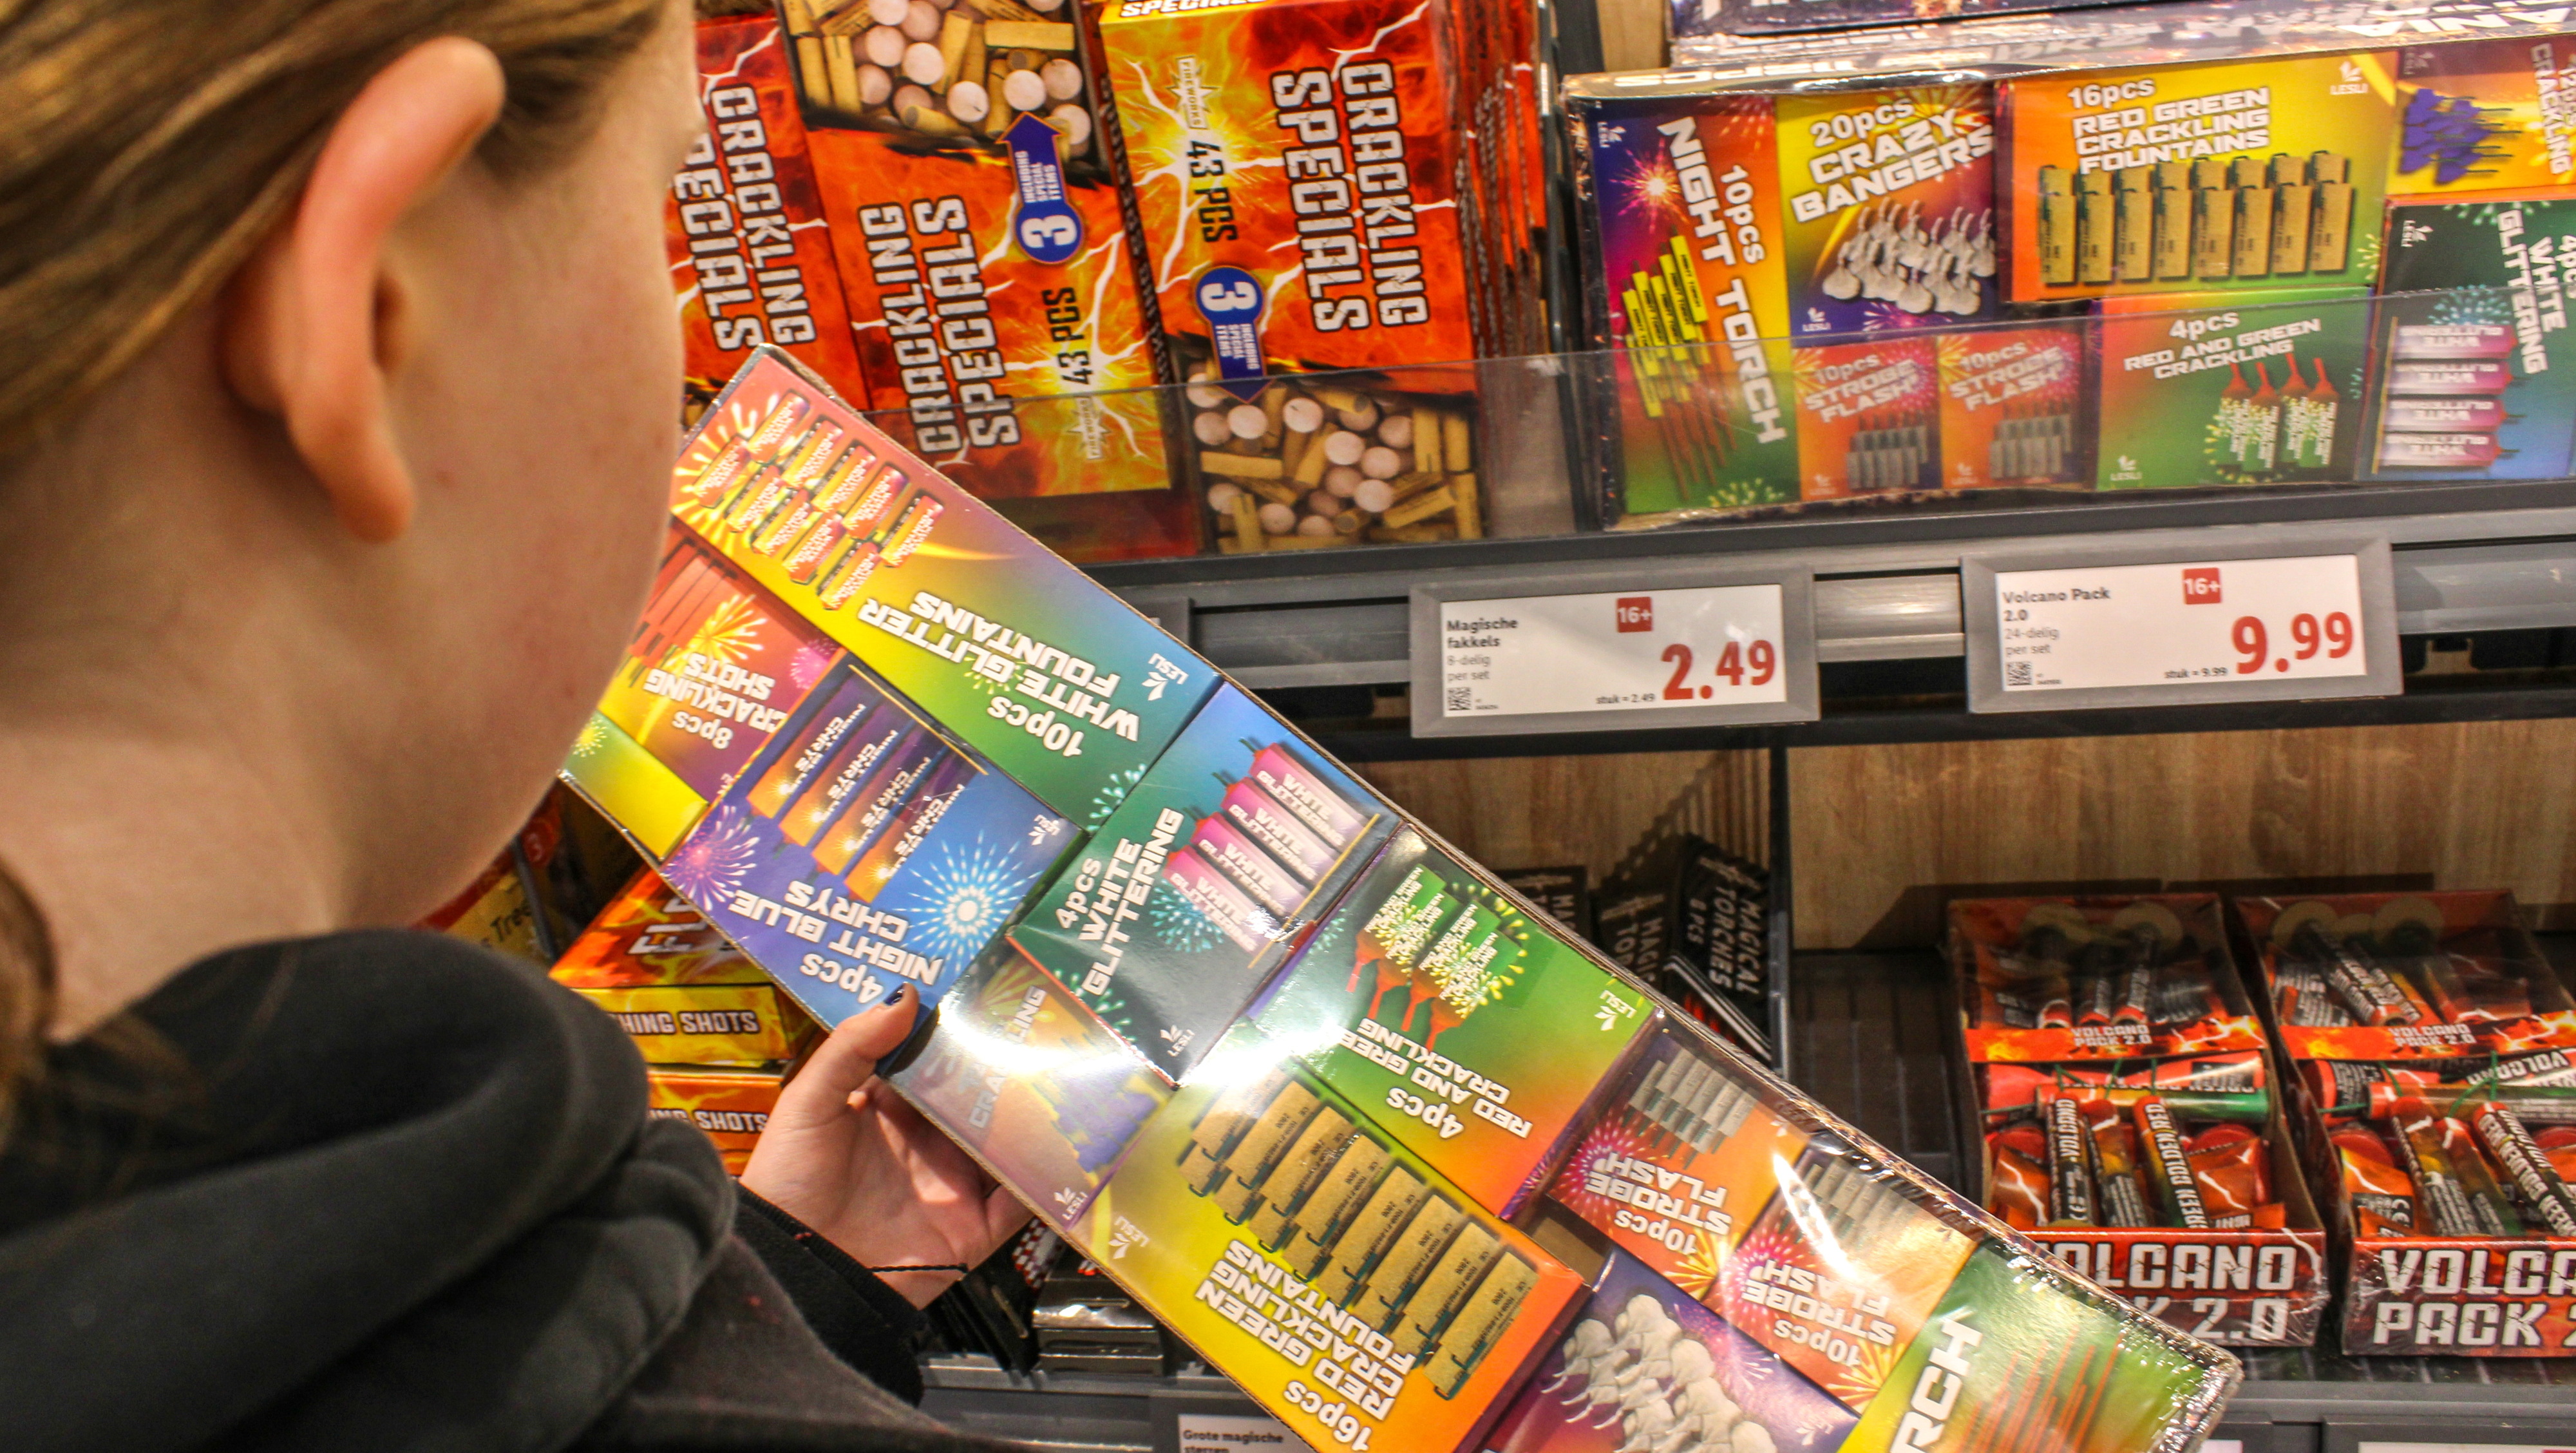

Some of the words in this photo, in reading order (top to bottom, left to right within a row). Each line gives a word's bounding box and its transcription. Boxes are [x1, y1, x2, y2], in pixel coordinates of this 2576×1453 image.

[2068, 79, 2155, 110] 16pcs
[2072, 108, 2146, 138] RED
[2154, 87, 2269, 130] GREEN
[2329, 82, 2369, 96] LESLI
[2530, 43, 2573, 175] CRACKLING
[1809, 109, 1957, 185] CRAZY
[1810, 98, 1915, 148] 20pcs
[2075, 108, 2269, 157] CRACKLING
[1186, 138, 1224, 177] 43
[1791, 125, 1994, 223] BANGERS
[2079, 129, 2269, 175] FOUNTAINS
[710, 84, 817, 345] CRACKLING
[1193, 186, 1238, 243] PCS
[1271, 70, 1370, 332] SPECIALS
[1340, 63, 1429, 327] CRACKLING
[1721, 165, 1765, 264] 10pcs
[673, 133, 765, 350] PECIALS
[1023, 214, 1075, 247] 3
[1200, 281, 1256, 312] 3
[1657, 117, 1737, 265] NIGHT
[1716, 278, 1787, 444] TORCH
[2497, 209, 2549, 375] GLITTERING
[2528, 236, 2568, 332] WHITE
[859, 205, 962, 453] CRACKLING
[913, 197, 1020, 447] SPECIALS
[1041, 287, 1084, 342] PCS
[2170, 312, 2239, 341] 4pcs
[1061, 350, 1093, 385] 43
[1815, 354, 1880, 385] 10pcs
[1960, 342, 2027, 372] 10pcs
[2124, 350, 2174, 373] RED
[2179, 336, 2232, 361] AND
[2237, 319, 2321, 348] GREEN
[2154, 339, 2294, 380] CRACKLING
[1804, 358, 1917, 410] STROBE
[1821, 372, 1920, 423] FLASH
[1948, 346, 2063, 399] STROBE
[1964, 361, 2067, 412] FLASH
[2003, 589, 2068, 604] Volcano
[2071, 586, 2110, 601] Pack
[2184, 577, 2221, 596] 16+
[1447, 617, 1518, 634] Magische
[1617, 605, 1653, 624] 16+
[2004, 609, 2028, 622] 2.0
[2004, 626, 2060, 641] 24-delig
[857, 598, 1021, 685] GLITTER
[909, 591, 1121, 699] FOUNTAINS
[1447, 634, 1501, 649] fakkels
[1447, 654, 1491, 669] 8-delig
[2005, 645, 2027, 656] per
[2031, 643, 2051, 654] set
[2231, 611, 2354, 674] 9.99
[683, 652, 775, 701] SHOTS
[1148, 653, 1188, 685] LESLI
[1447, 670, 1466, 683] per
[1470, 669, 1490, 680] set
[1661, 640, 1776, 701] 2.49
[2201, 666, 2228, 677] 9.99
[643, 667, 787, 734] CRACKLING
[1016, 668, 1139, 741] WHITE
[672, 710, 733, 750] 8pcs
[987, 696, 1083, 758] 10pcs
[1281, 773, 1331, 821] WHITE
[1253, 807, 1302, 855] WHITE
[1079, 837, 1143, 942] WHITE
[1223, 842, 1273, 891] WHITE
[728, 889, 828, 944] BLUE
[785, 878, 909, 943] CHRYS
[1055, 857, 1102, 929] 4pcs
[1081, 807, 1184, 996] GLITTERING
[1194, 876, 1244, 925] WHITE
[828, 929, 944, 987] NIGHT
[1708, 886, 1738, 989] TORCHES
[1735, 897, 1763, 995] MAGICAL
[800, 953, 884, 1004] 4pcs
[680, 1011, 760, 1032] SHOTS
[1599, 990, 1637, 1020] LESLI
[967, 984, 1046, 1129] CRALING
[1338, 1030, 1411, 1076] GREE
[1356, 1017, 1511, 1103] CRACKLING
[1410, 1065, 1473, 1106] AND
[694, 1109, 769, 1132] SHOTS
[1386, 1086, 1465, 1140] 4pcs
[1473, 1096, 1534, 1140] RED
[1584, 1171, 1732, 1236] STROBE
[1607, 1151, 1728, 1210] FLASH
[1061, 1192, 1088, 1221] LESLI
[1113, 1215, 1150, 1248] LESLI
[1615, 1207, 1698, 1257] 10pcs
[1763, 1259, 1889, 1318] FLASH
[2054, 1244, 2297, 1291] OLCANO
[2380, 1249, 2576, 1296] VOLCA
[1194, 1279, 1312, 1367] GREEN
[1210, 1259, 1404, 1401] CRACKLING
[1225, 1240, 1417, 1376] FOUNTAINS
[1741, 1276, 1897, 1347] STROBE
[2192, 1297, 2288, 1341] 2.0
[2373, 1302, 2546, 1346] PACK
[1774, 1318, 1860, 1367] 10pcs
[1312, 1357, 1396, 1421] RED
[1890, 1318, 1984, 1453] RCH
[1183, 1429, 1219, 1441] Grote
[1222, 1430, 1283, 1445] magische
[1283, 1380, 1372, 1452] 16pcs
